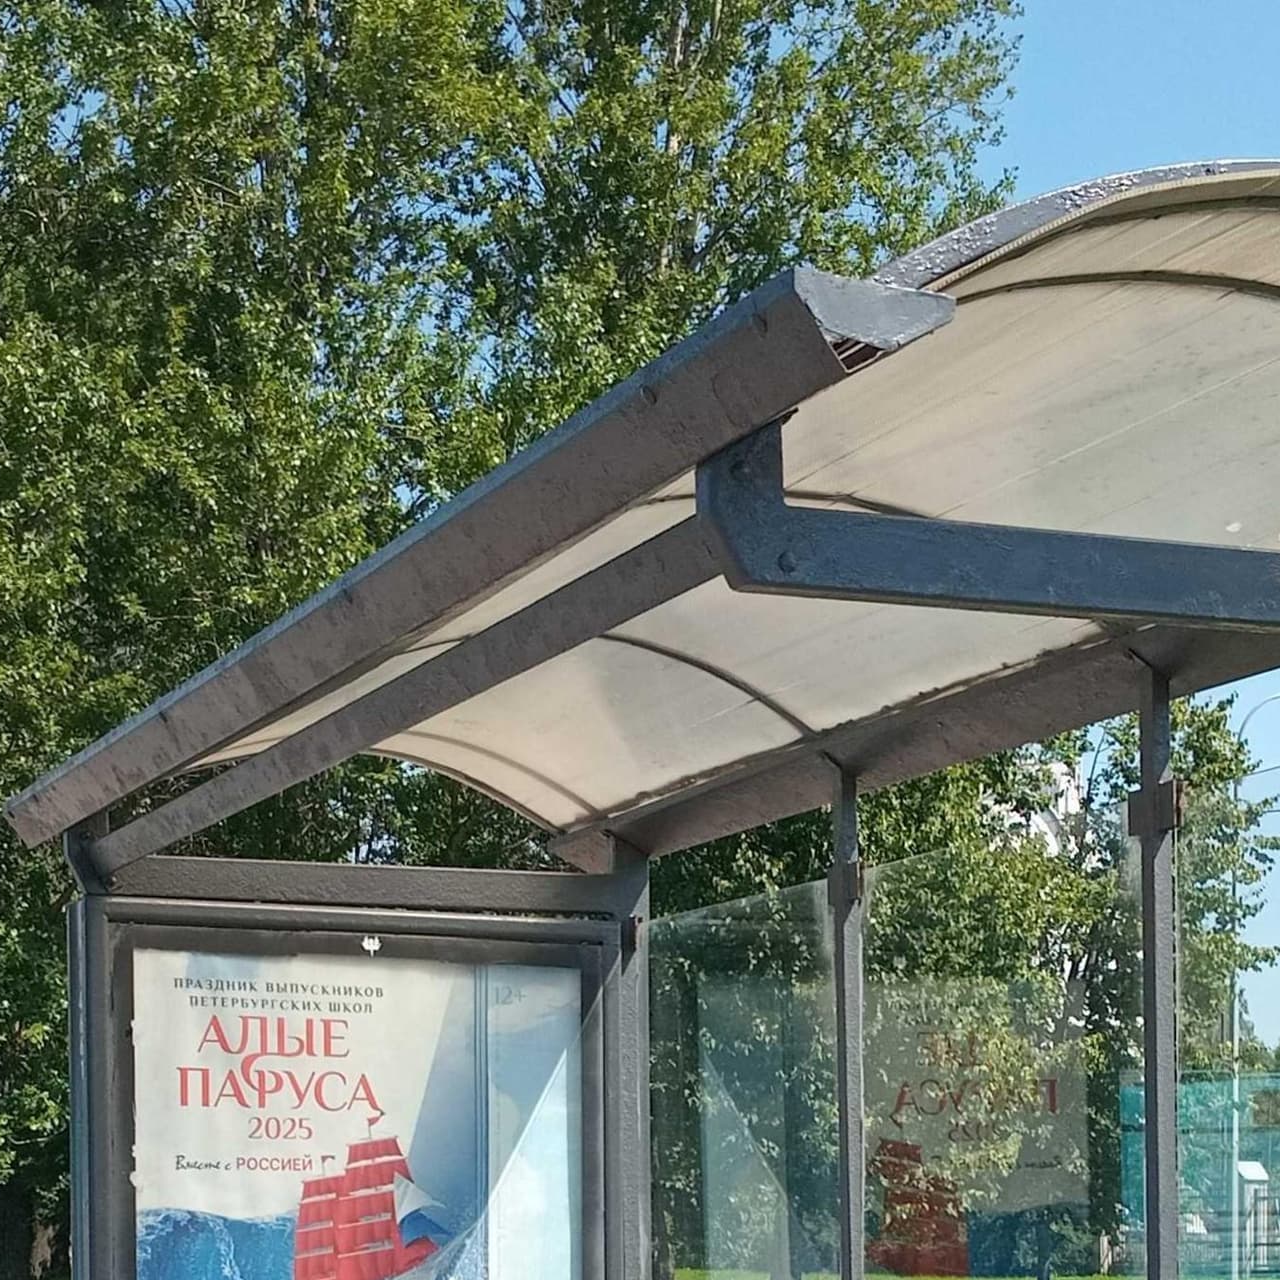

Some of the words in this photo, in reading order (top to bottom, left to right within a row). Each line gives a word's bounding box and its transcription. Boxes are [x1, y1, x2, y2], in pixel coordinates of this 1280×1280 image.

[173, 977, 259, 993] ПРАЗДНИК
[266, 981, 385, 999] ВЫПУСКНИКОВ
[495, 985, 528, 1006] 12+
[189, 995, 323, 1013] ПЕТЕРБУРГСКИХ
[328, 1002, 373, 1015] ШКОЛ
[197, 1014, 351, 1059] АЛЫЕ
[176, 1065, 387, 1117] ПАРУСА
[248, 1116, 314, 1141] 2025
[175, 1154, 221, 1171] Вместе
[235, 1154, 314, 1172] РОССИЕЙ
